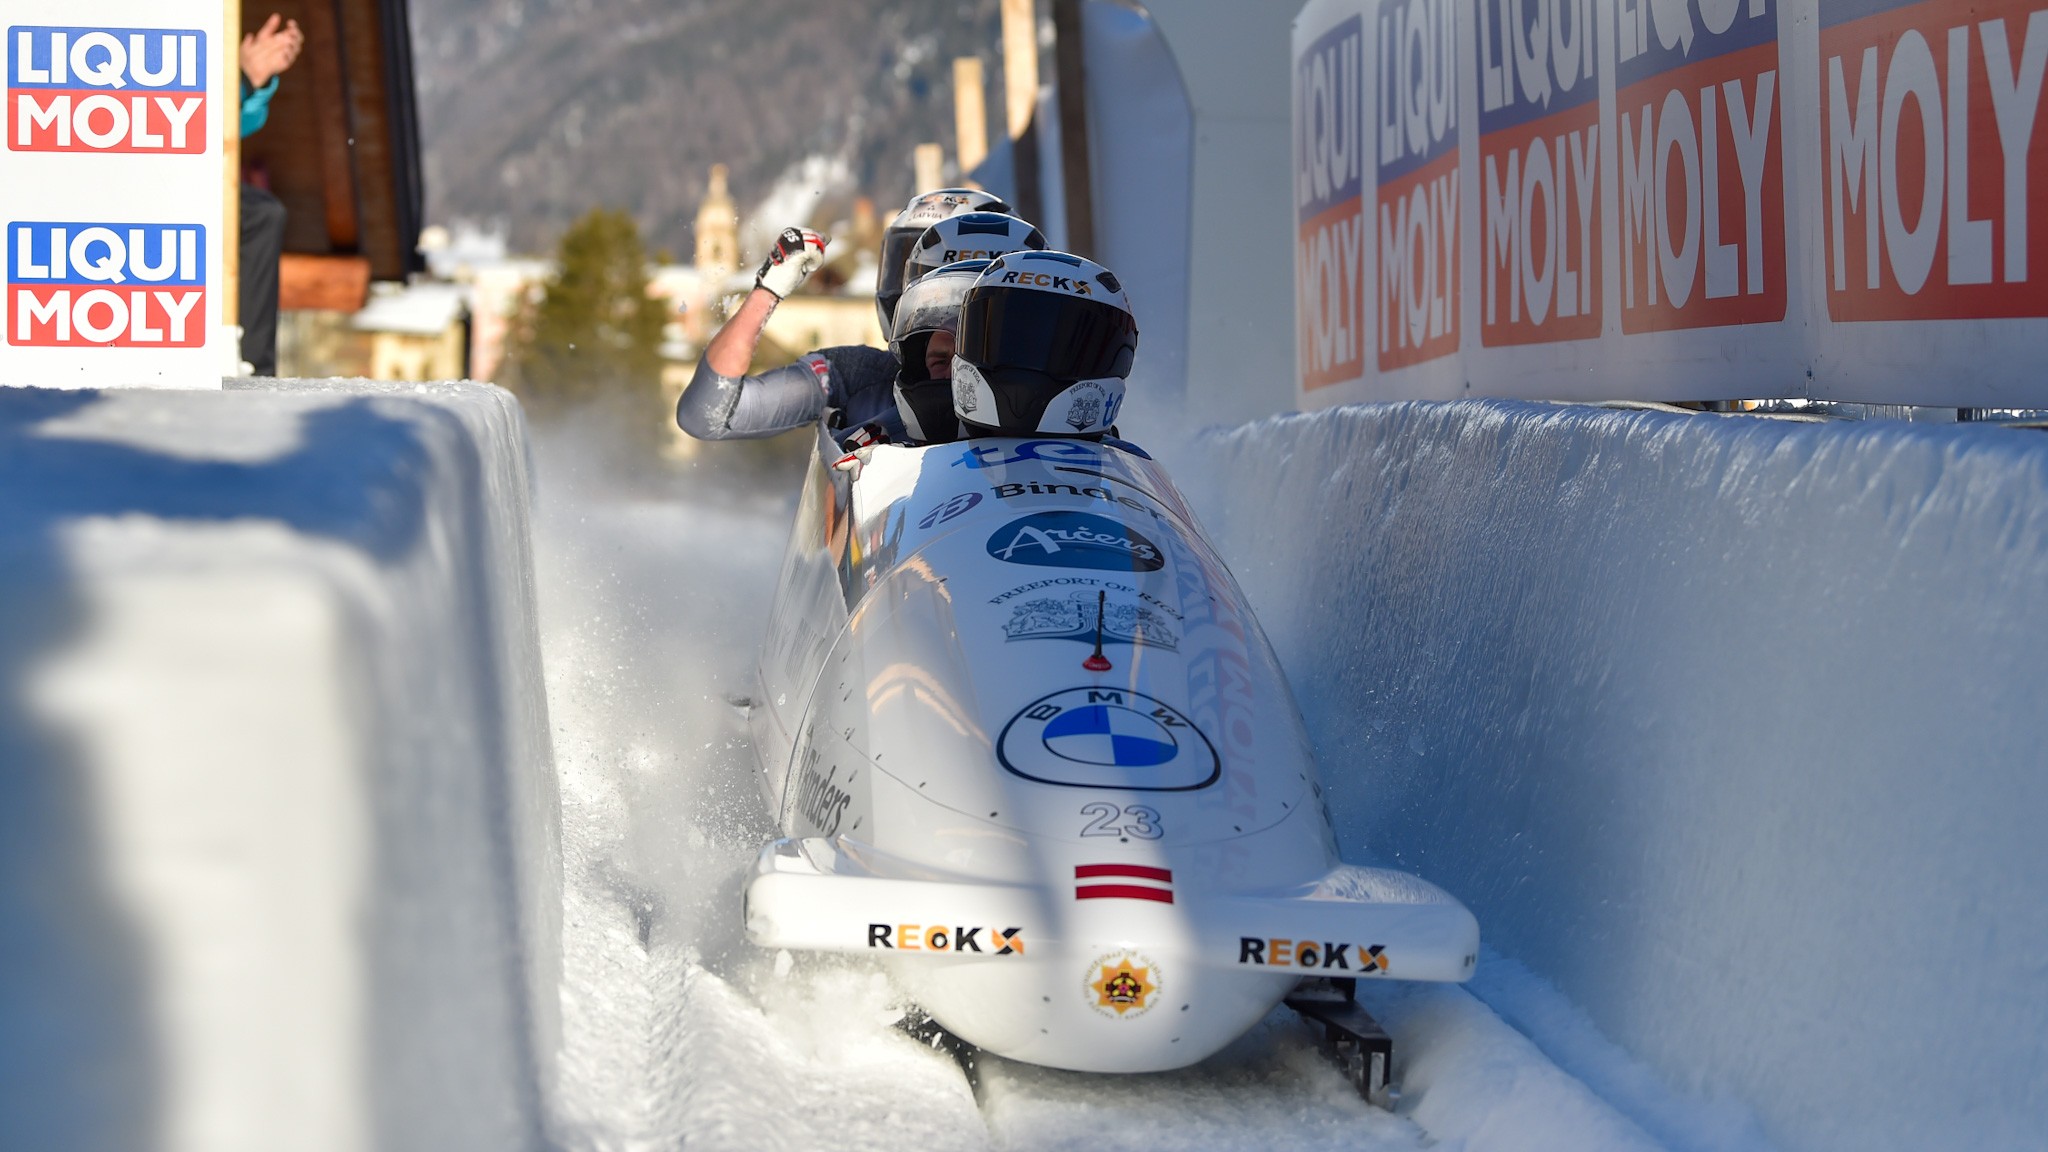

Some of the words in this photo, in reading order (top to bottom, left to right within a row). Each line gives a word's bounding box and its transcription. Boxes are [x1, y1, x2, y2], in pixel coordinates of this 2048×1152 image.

[18, 32, 197, 89] LIQUI
[17, 95, 203, 148] MOLY
[1828, 19, 2048, 295] MOLY
[1621, 70, 1775, 309] MOLY
[1485, 124, 1598, 327] MOLY
[17, 227, 197, 284] LIQUI
[1382, 168, 1459, 354] MOLY
[17, 289, 203, 342] MOLY
[987, 577, 1100, 606] FREEPORT
[1104, 581, 1136, 592] OF
[1137, 591, 1186, 622] RIGA
[1025, 690, 1188, 729] BMW
[1080, 802, 1164, 840] 23
